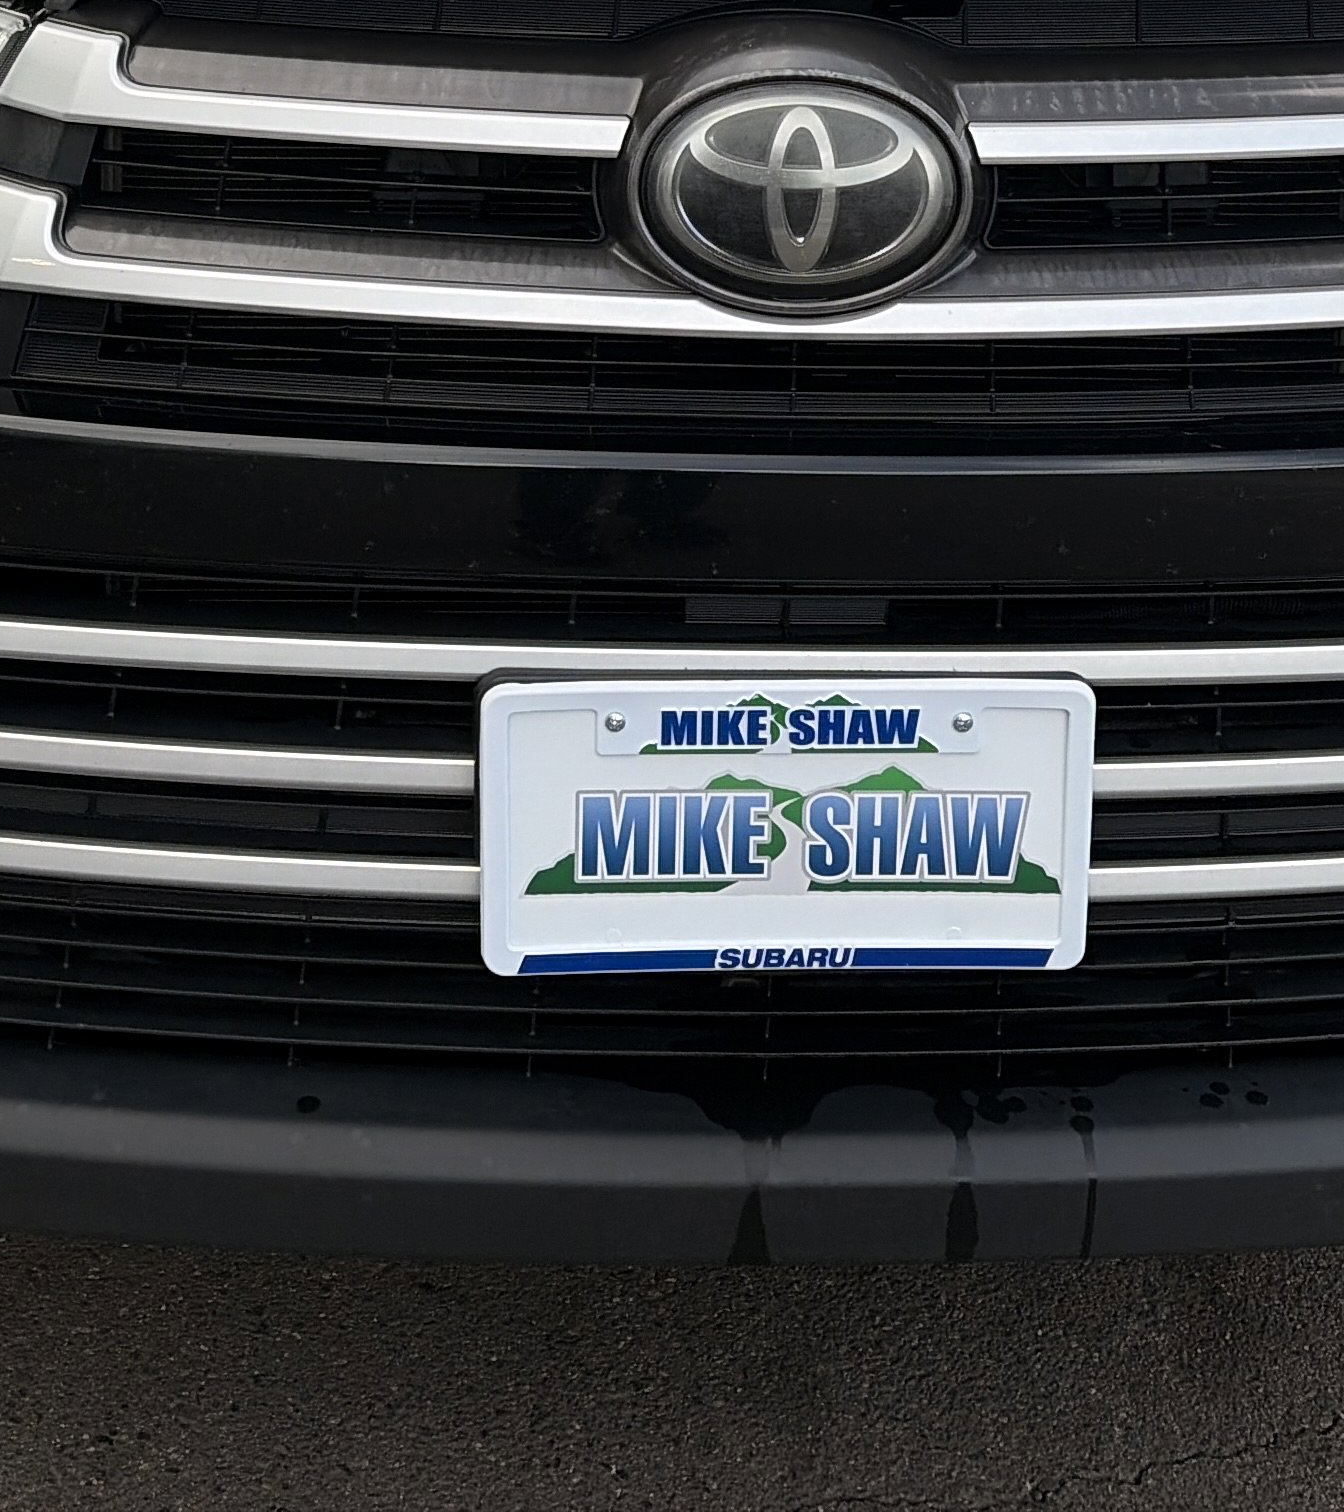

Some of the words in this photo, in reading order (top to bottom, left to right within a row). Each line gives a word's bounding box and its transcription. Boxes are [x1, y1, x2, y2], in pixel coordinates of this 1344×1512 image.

[660, 709, 769, 746] MIKE
[789, 708, 920, 745] SHAW
[578, 792, 771, 879] MIKE
[806, 792, 1028, 879] SHAW
[718, 947, 854, 969] SUBARU
